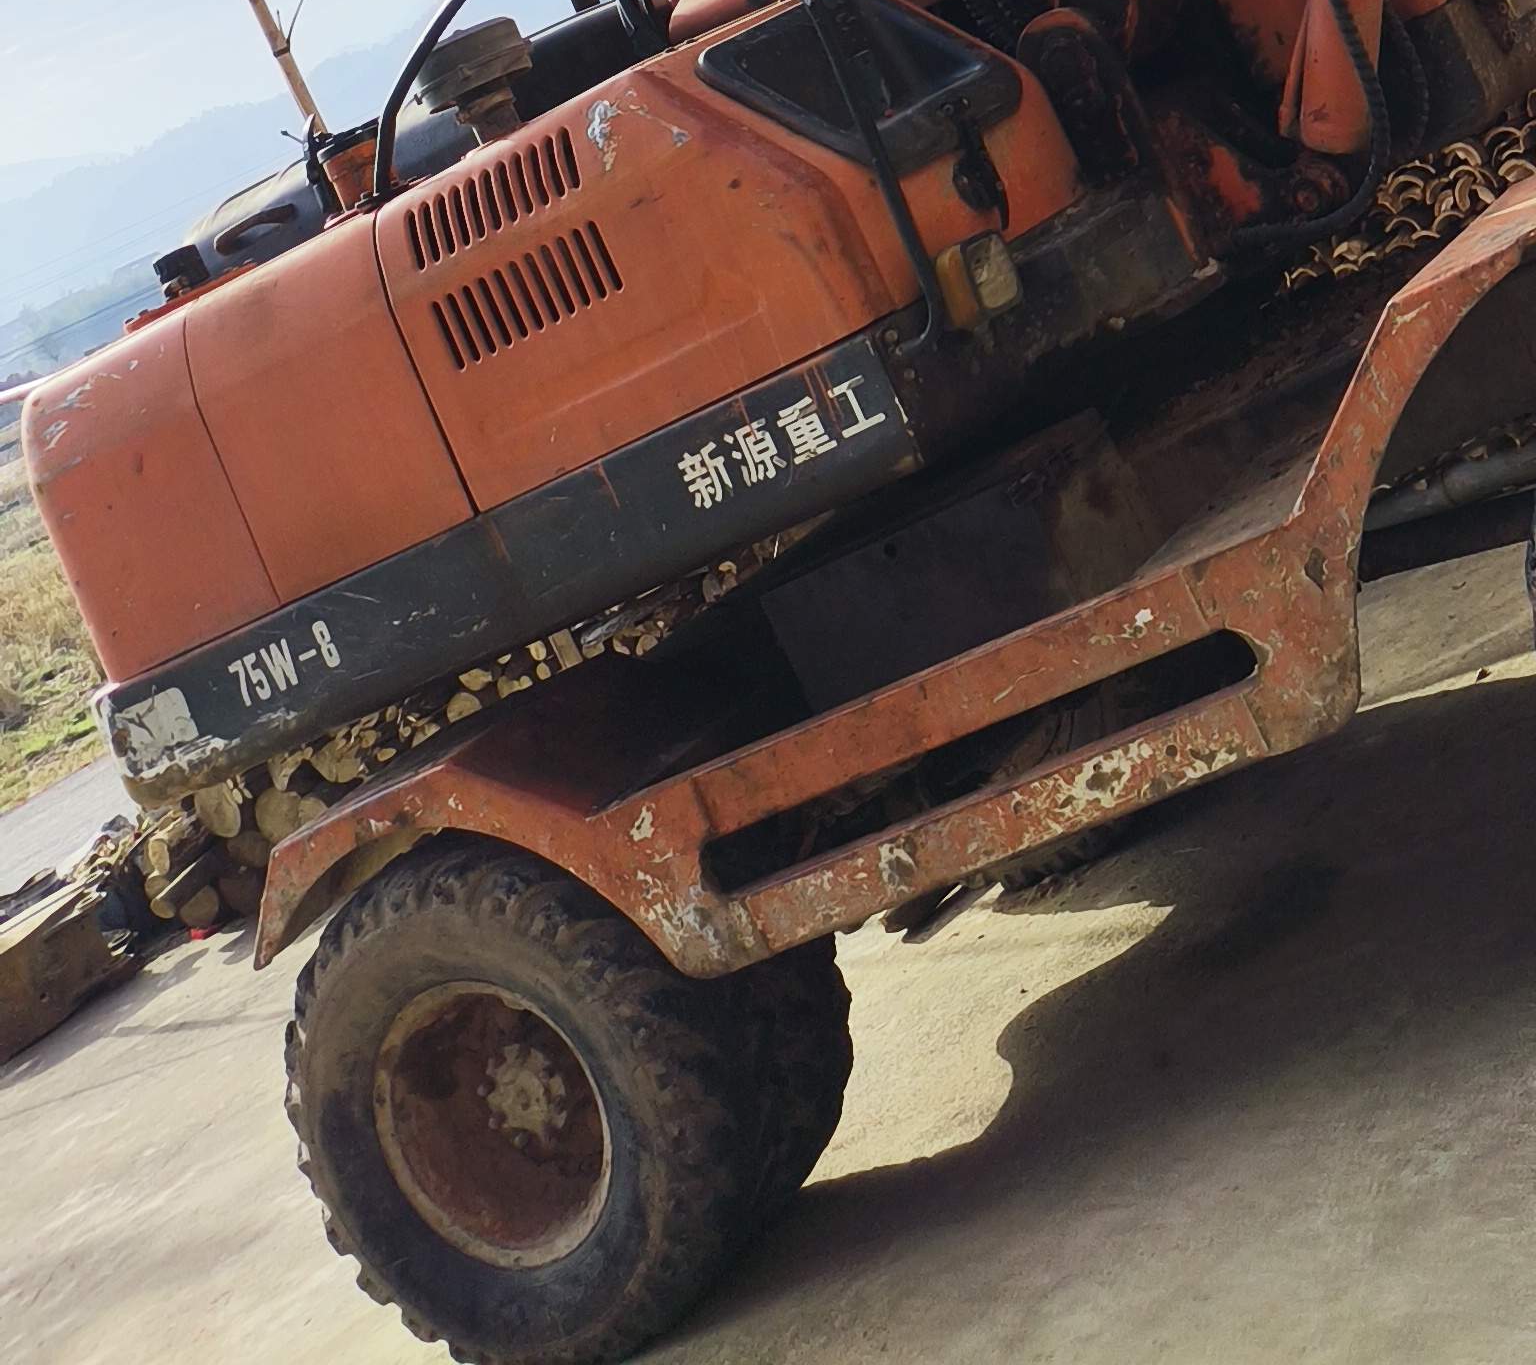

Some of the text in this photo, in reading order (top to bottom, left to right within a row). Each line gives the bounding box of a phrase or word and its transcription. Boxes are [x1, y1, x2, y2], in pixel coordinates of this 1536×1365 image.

[677, 374, 887, 510] 新源重工
[227, 620, 341, 707] 75W-8
